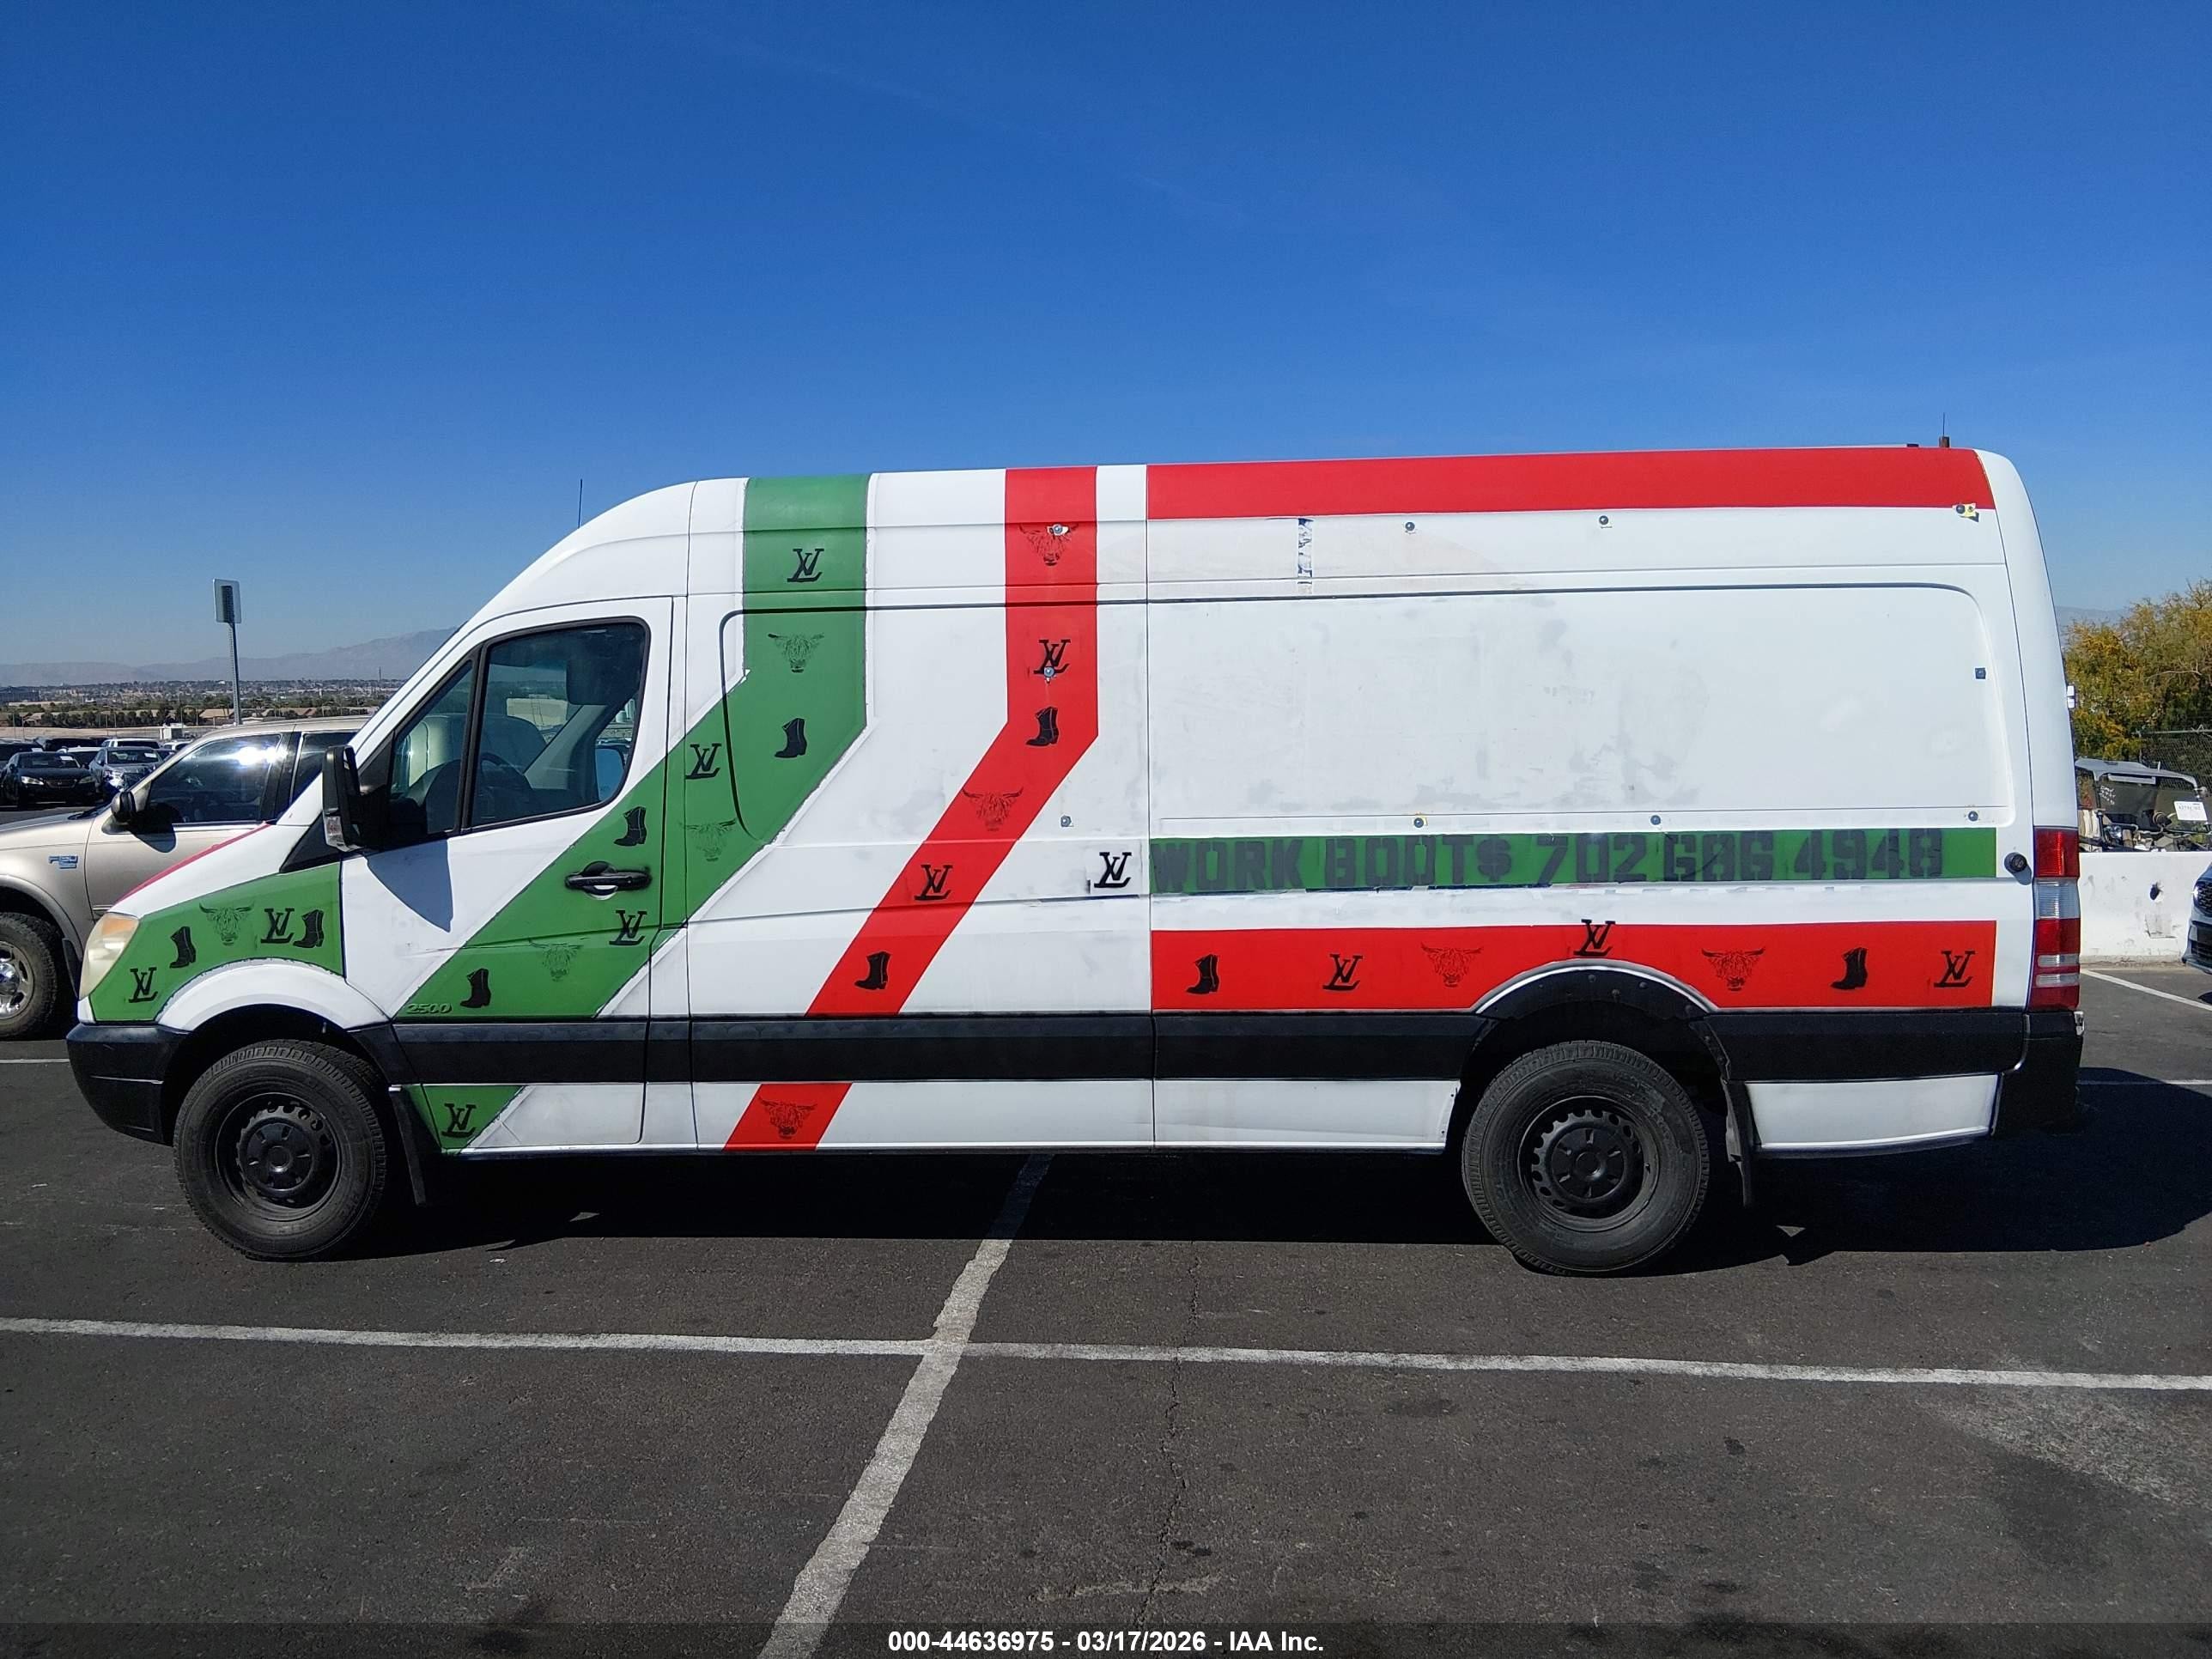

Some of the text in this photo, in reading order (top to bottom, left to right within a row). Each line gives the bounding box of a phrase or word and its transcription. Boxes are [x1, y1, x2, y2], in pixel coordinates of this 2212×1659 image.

[1150, 840, 1303, 893] WORK
[1536, 832, 1647, 886] 702
[1793, 829, 1943, 880] 4948
[405, 1003, 452, 1014] 2500
